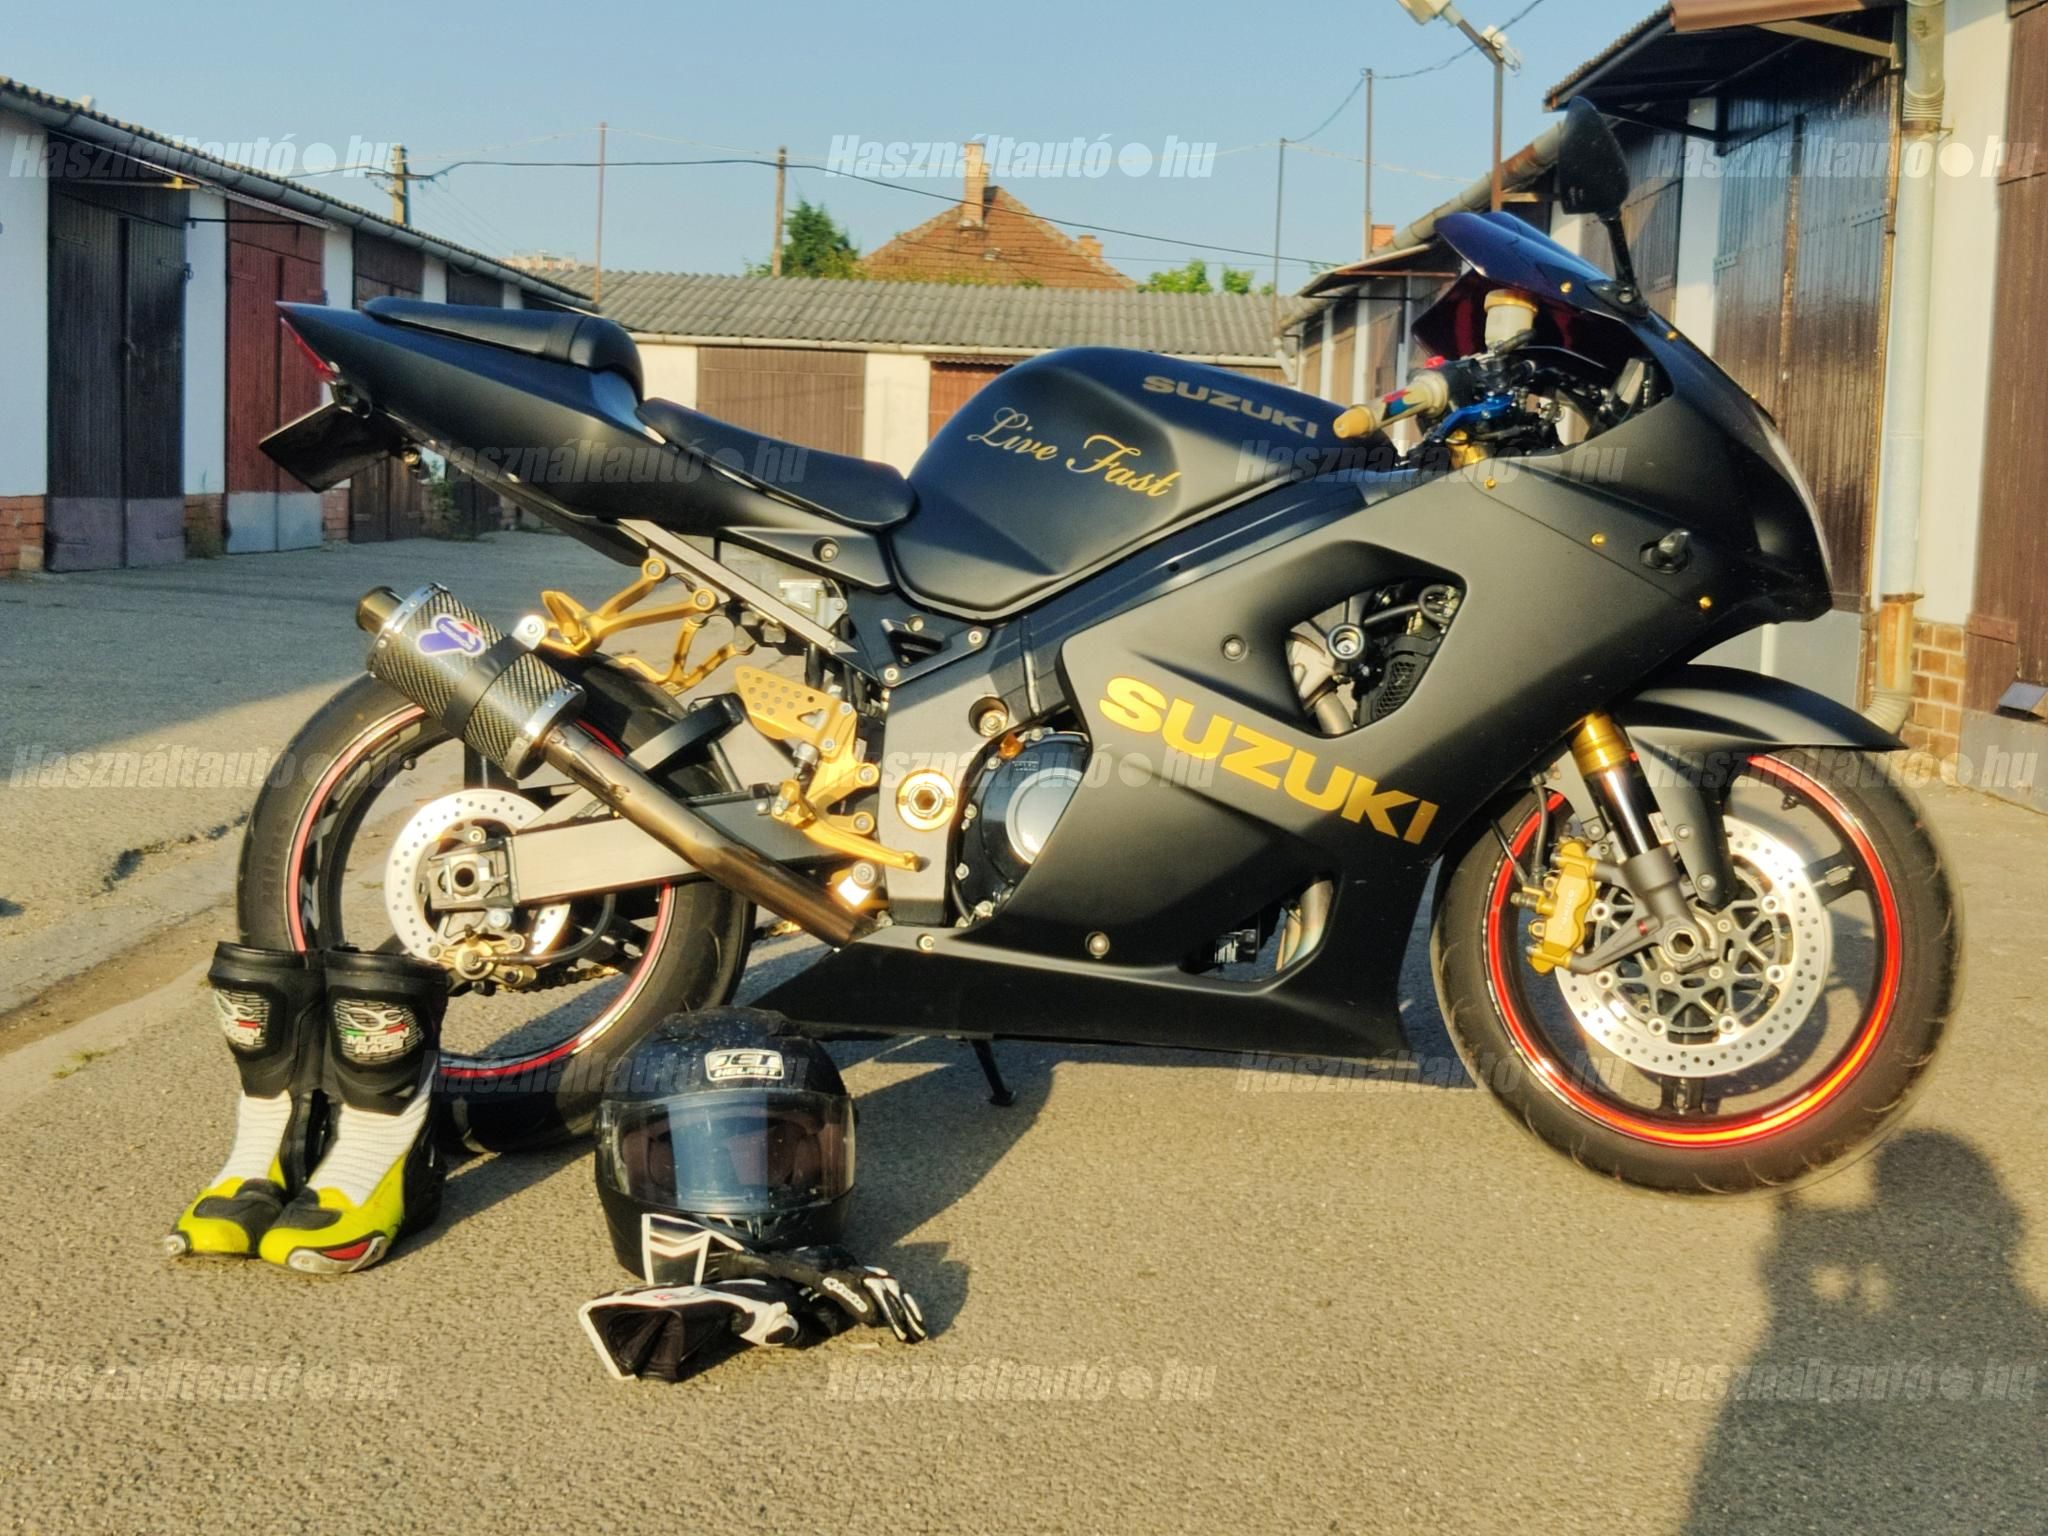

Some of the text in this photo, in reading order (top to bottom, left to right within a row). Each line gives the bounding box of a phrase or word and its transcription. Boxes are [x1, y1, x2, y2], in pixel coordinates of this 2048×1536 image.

[967, 407, 1181, 496] Live Fast
[1143, 376, 1318, 438] SUZUKI
[1099, 675, 1439, 846] SUZUKI
